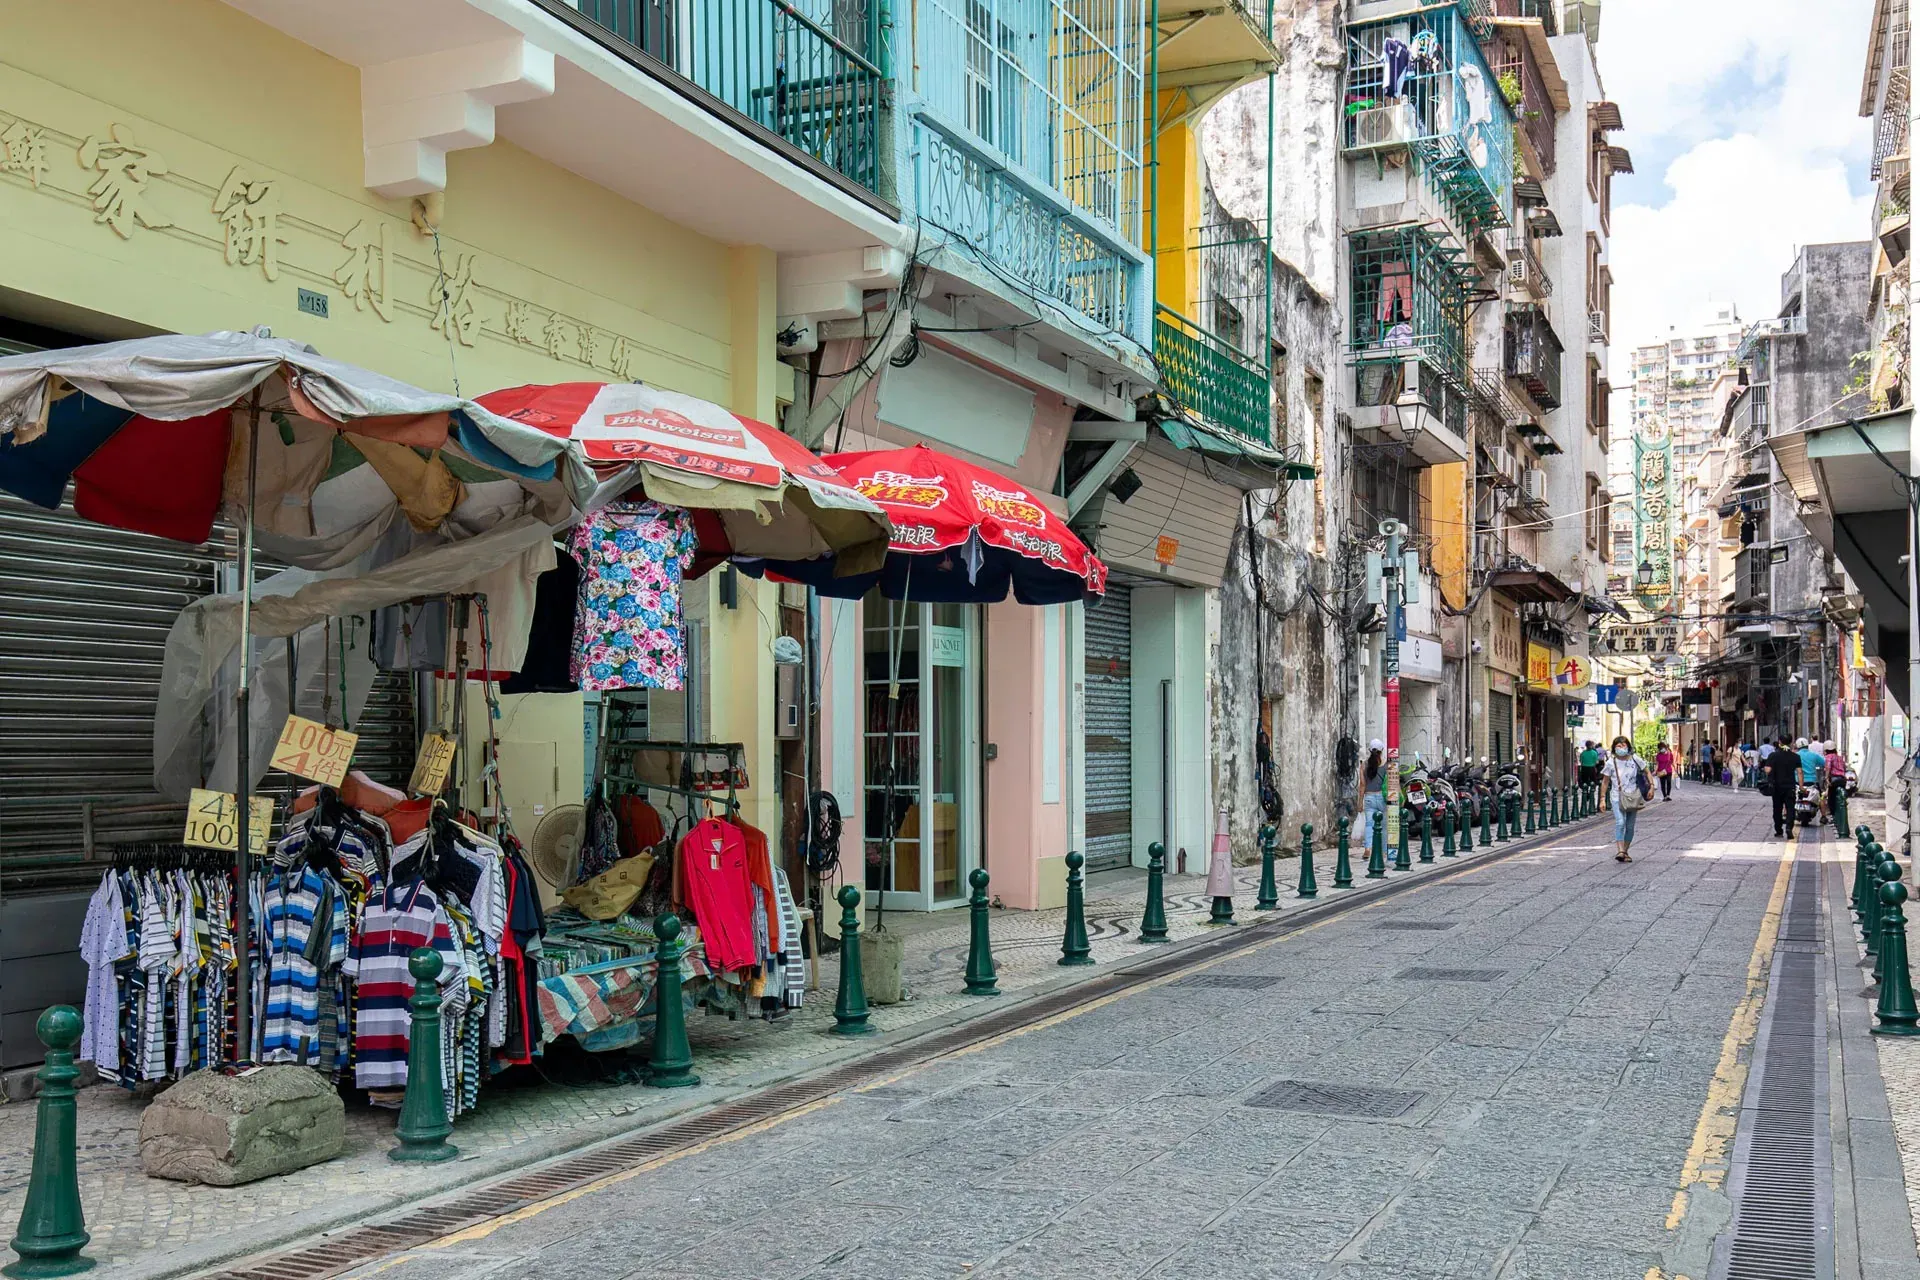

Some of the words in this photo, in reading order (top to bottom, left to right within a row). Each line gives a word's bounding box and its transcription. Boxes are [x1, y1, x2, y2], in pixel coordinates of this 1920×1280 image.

[611, 415, 740, 443] Budweiser
[1610, 628, 1628, 637] EAST
[1633, 627, 1650, 636] ASIA
[1655, 626, 1678, 635] HOTEL
[280, 719, 353, 762] 100元
[277, 751, 343, 784] 4件
